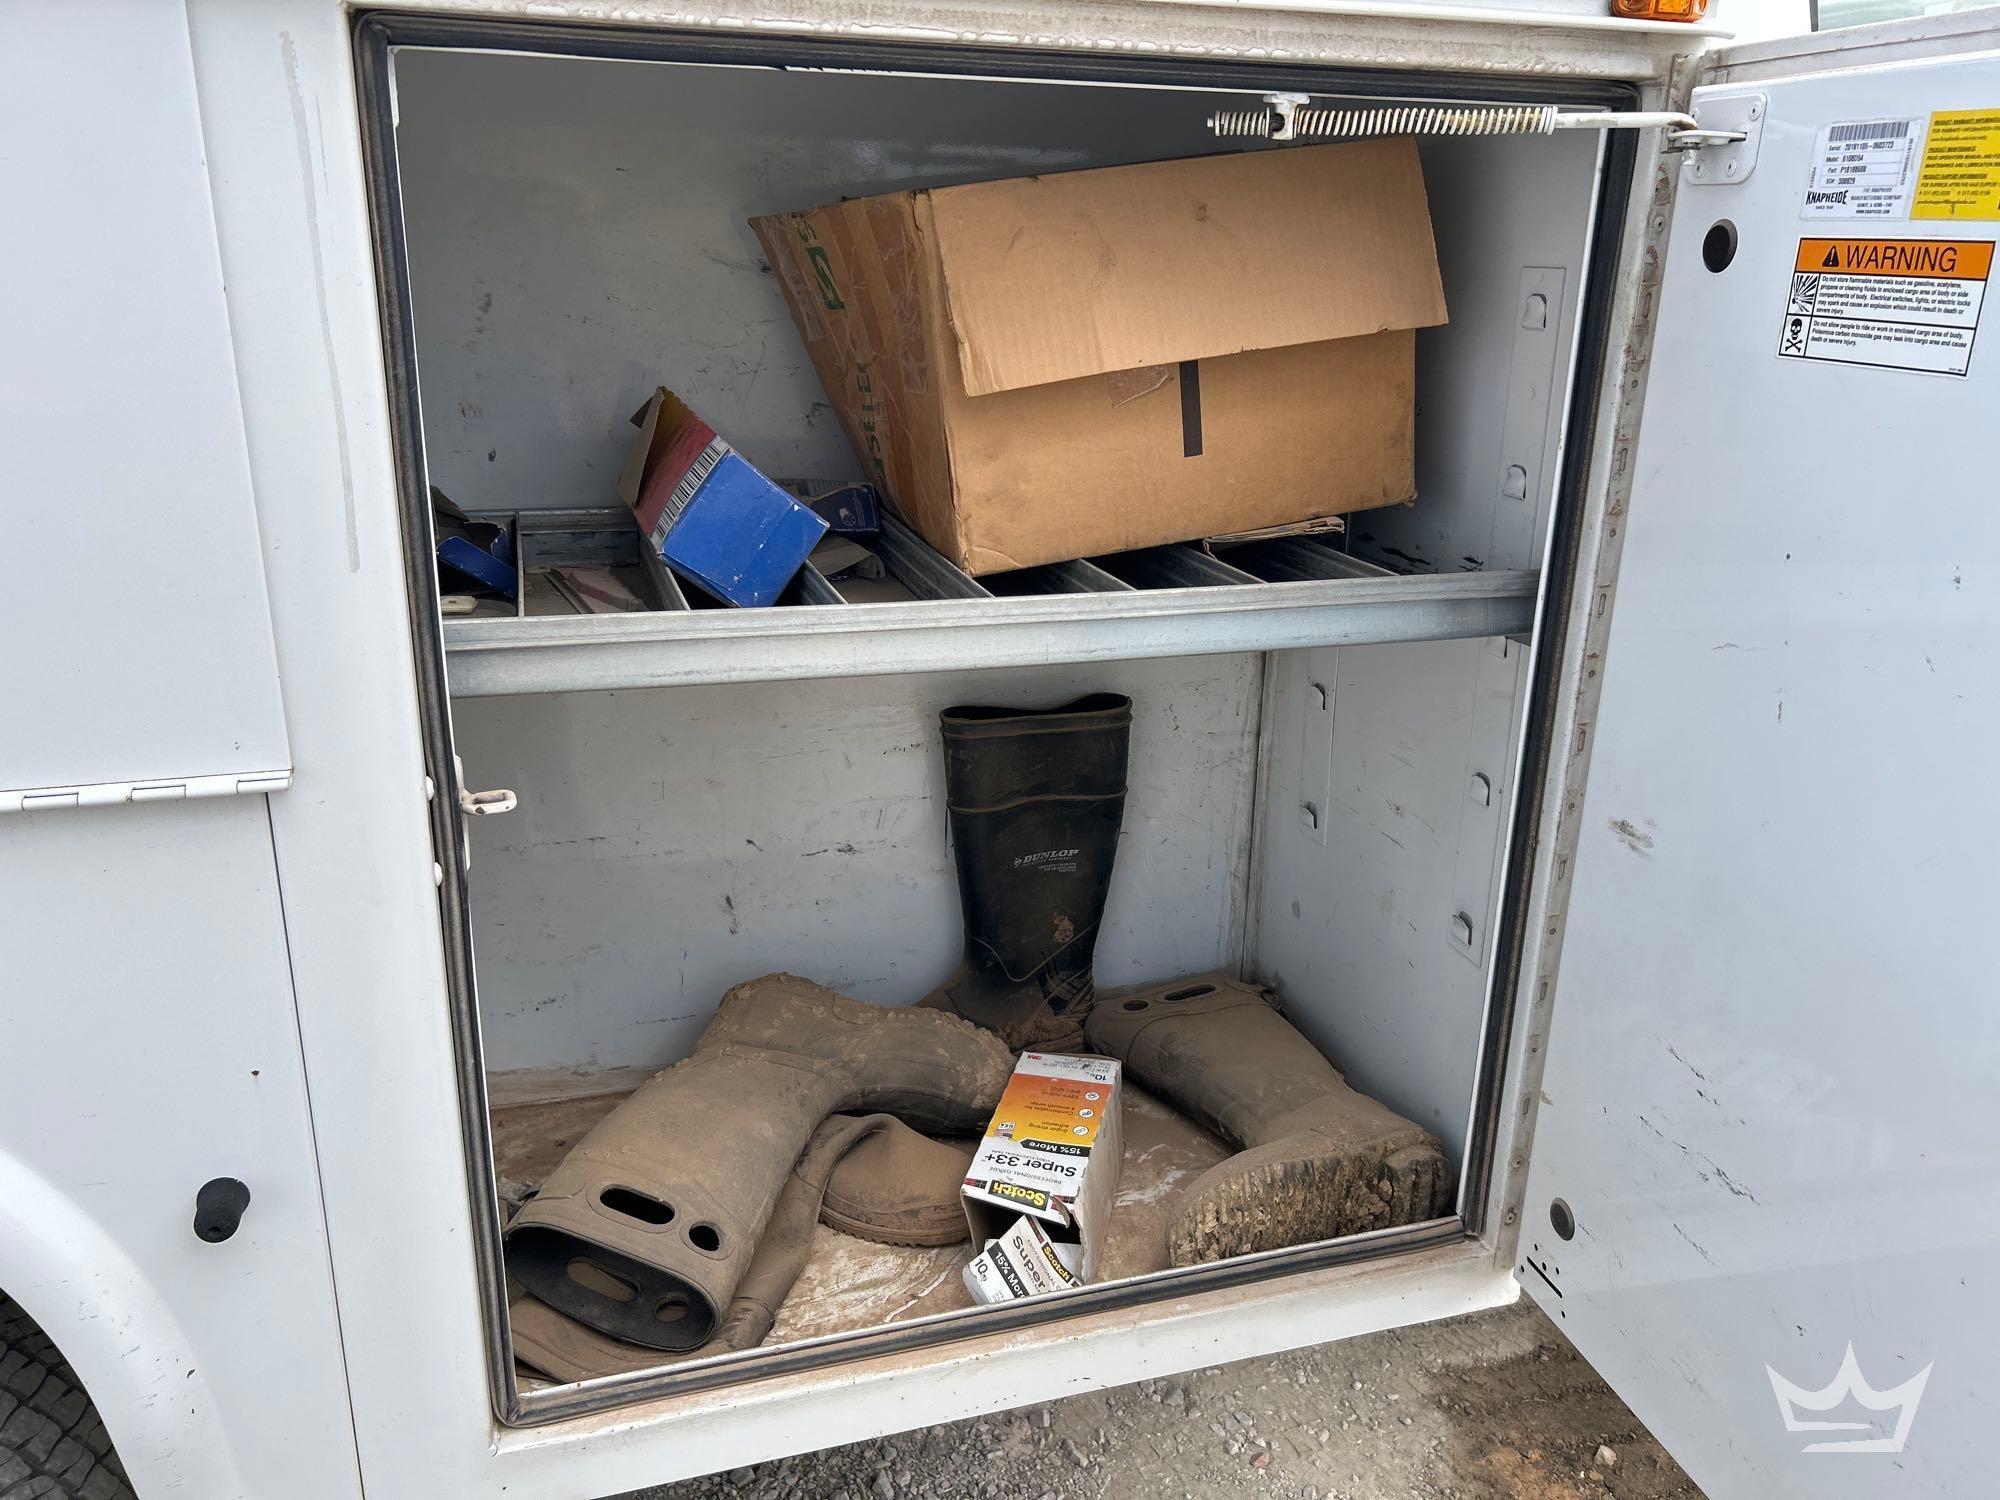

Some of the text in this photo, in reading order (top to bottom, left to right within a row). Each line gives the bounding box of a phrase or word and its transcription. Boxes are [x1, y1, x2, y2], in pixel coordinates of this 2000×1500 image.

[1806, 190, 1848, 205] KNAPHEIDE
[1846, 245, 1957, 272] WARNING
[1818, 291, 1849, 299] compartments
[1844, 284, 1863, 292] cleaning
[1936, 289, 1950, 297] body
[1827, 299, 1839, 307] spark
[1869, 302, 1892, 310] explosion
[1839, 322, 1855, 330] people
[1894, 326, 1916, 334] enclosed
[1916, 329, 1930, 337] cargo
[1022, 849, 1080, 864] DUNLOP
[1029, 1122, 1049, 1130] strong
[1042, 1120, 1069, 1128] adhesion
[1029, 1141, 1081, 1155] 15% More
[985, 1153, 1077, 1177] Super 33+
[1013, 1170, 1062, 1185] PROFESSIONAL
[993, 1182, 1046, 1206] Scotch
[975, 1259, 988, 1275] 10
[994, 1252, 1011, 1275] 15%
[1013, 1235, 1046, 1288] Super
[1027, 1239, 1056, 1287] PROFESSIONAL
[1044, 1246, 1070, 1280] Scotch
